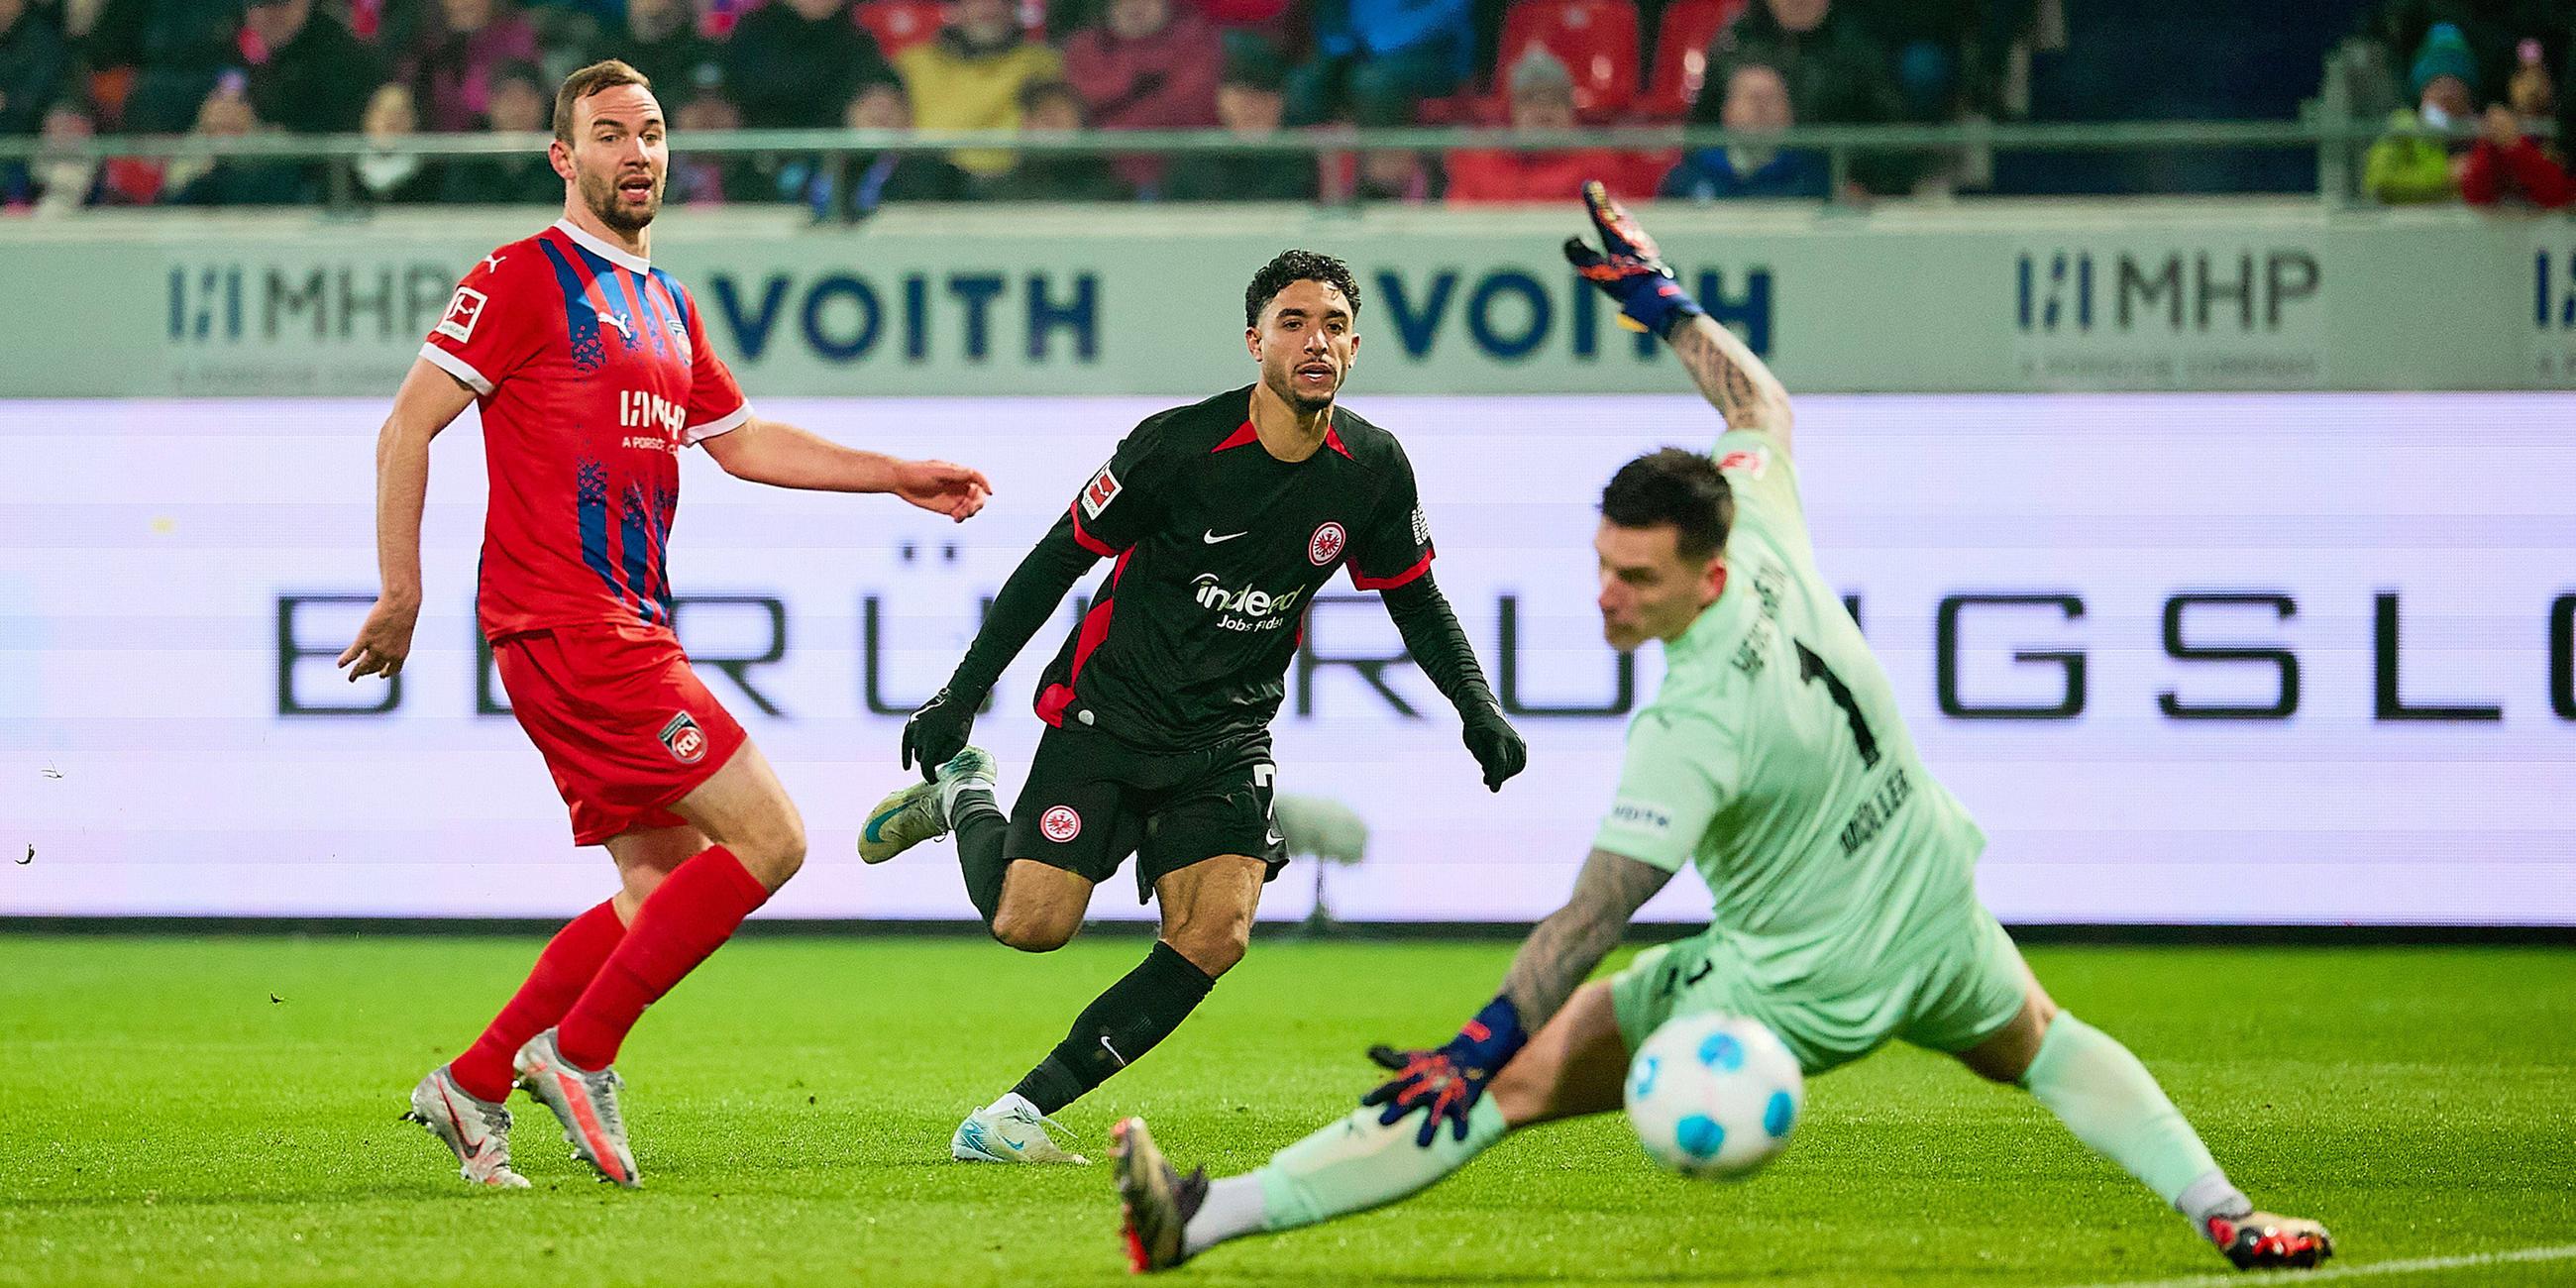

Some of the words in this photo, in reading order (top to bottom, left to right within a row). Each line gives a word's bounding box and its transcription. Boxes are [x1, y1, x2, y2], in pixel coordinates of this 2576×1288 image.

[265, 265, 456, 339] MHP
[709, 269, 1099, 363] VOITH
[2117, 251, 2320, 330] MHP
[1189, 573, 1306, 616] indeed
[1217, 614, 1253, 632] Jobs
[1793, 637, 1880, 771] 1
[1253, 764, 1275, 820] 7
